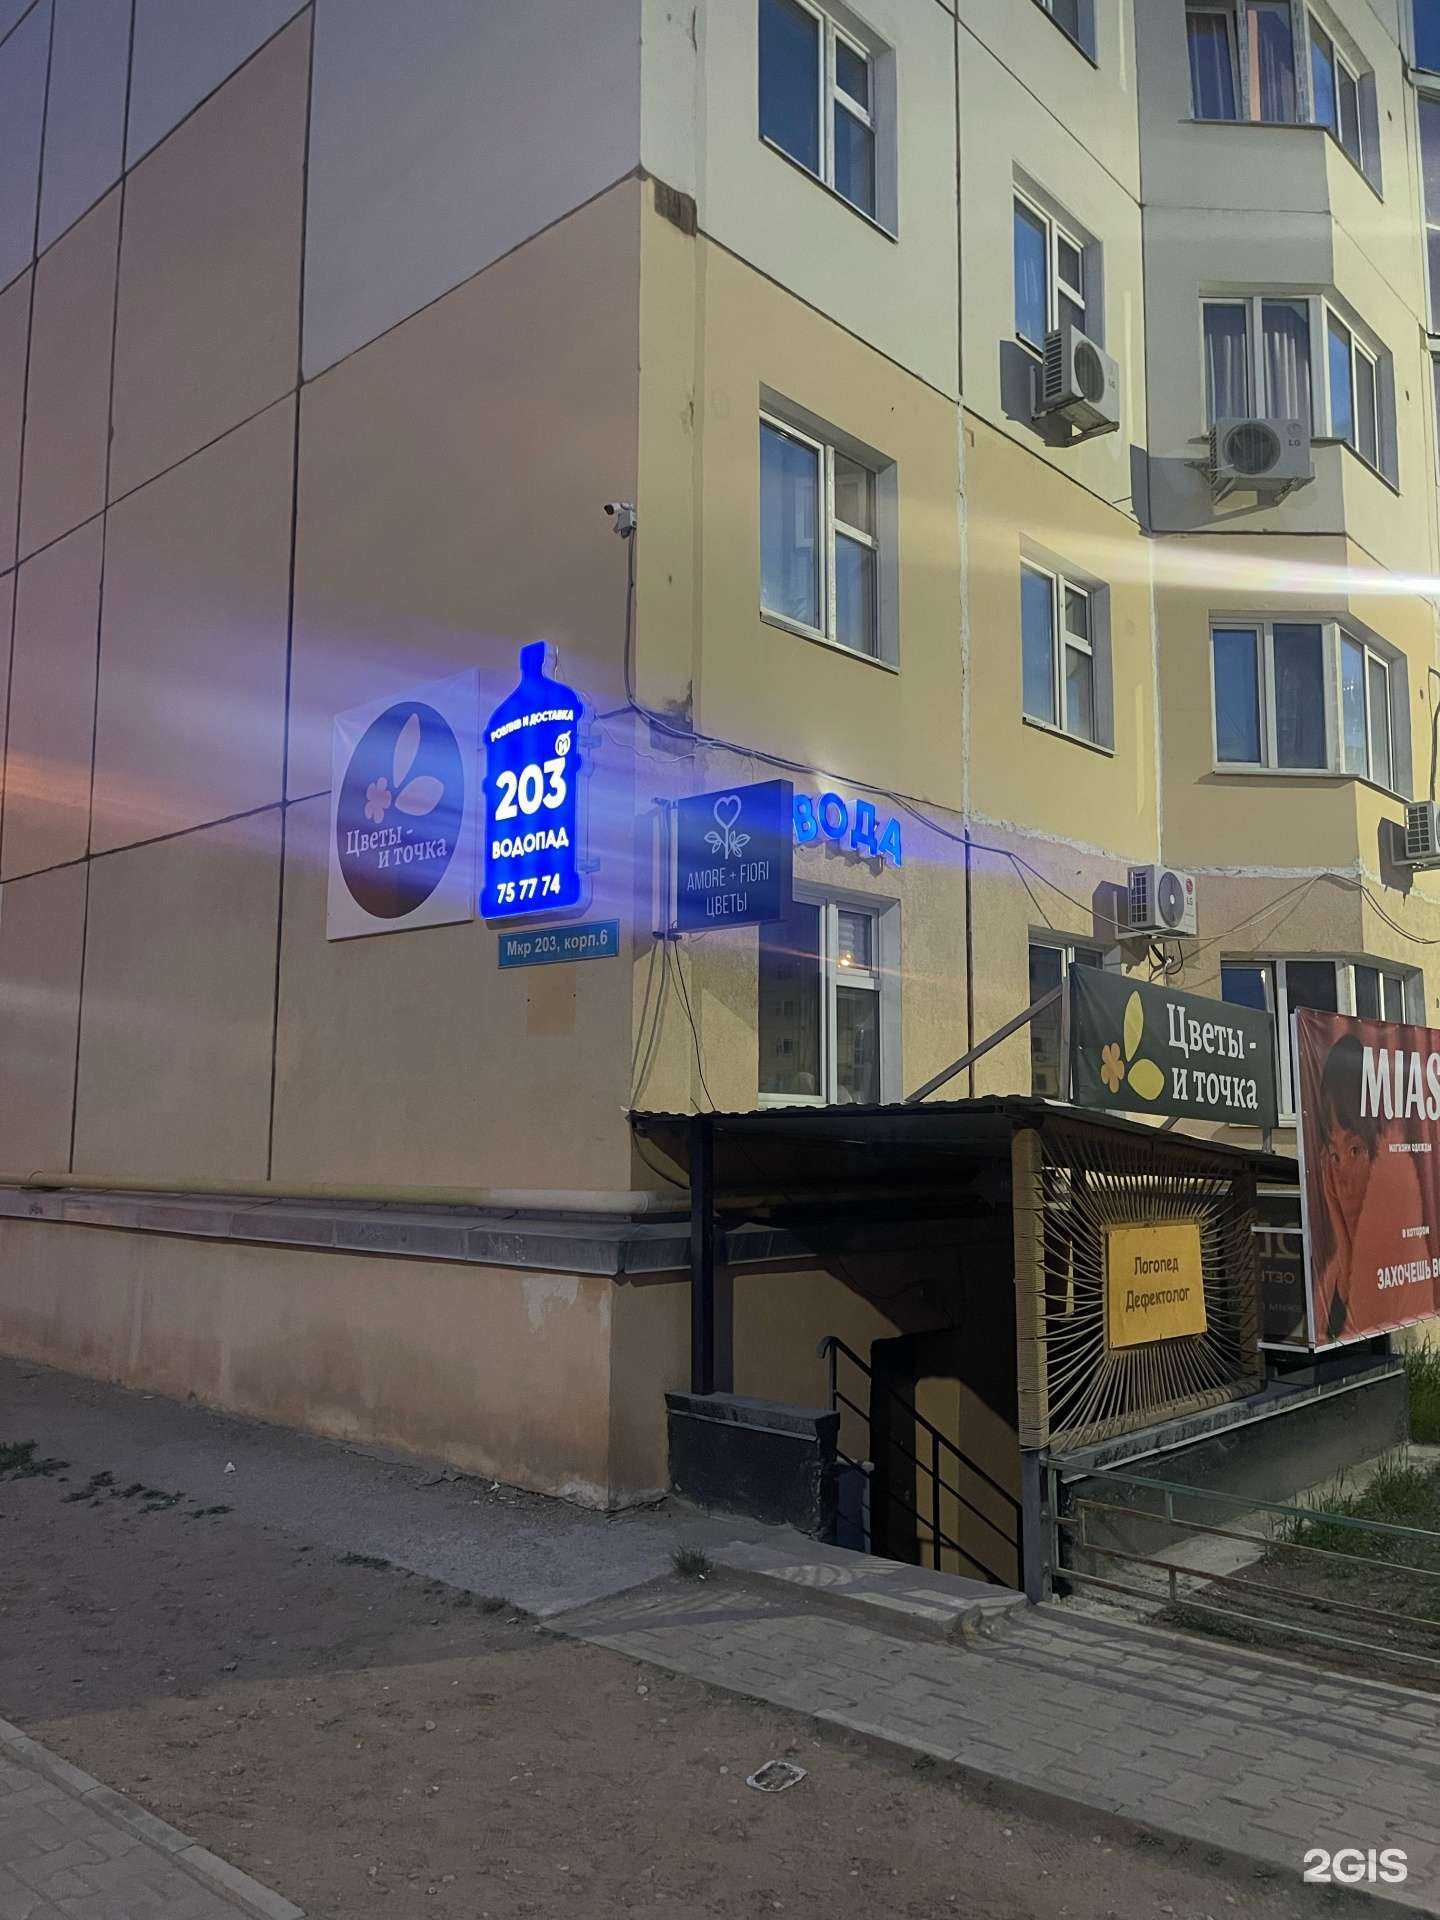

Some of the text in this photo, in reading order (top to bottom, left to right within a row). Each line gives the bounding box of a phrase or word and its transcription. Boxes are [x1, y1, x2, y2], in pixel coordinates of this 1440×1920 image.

[495, 756, 567, 821] 203
[345, 825, 402, 858] Цветы
[492, 826, 570, 860] ВОДОПАД
[793, 791, 902, 868] ВОДА
[393, 837, 448, 866] точка
[497, 872, 561, 905] 75 77 74
[687, 867, 726, 891] AMORE
[740, 860, 769, 884] FIORI
[706, 892, 748, 917] ЦВЕТЫ
[507, 940, 532, 958] Мкр
[535, 935, 560, 954] 203,
[1166, 1003, 1245, 1060] Цветы
[1192, 1070, 1259, 1111] точка
[1134, 1256, 1179, 1275] Логопед
[1376, 1259, 1431, 1290] ЗАХОЧЕШЬ
[1125, 1288, 1190, 1313] Дефектолог
